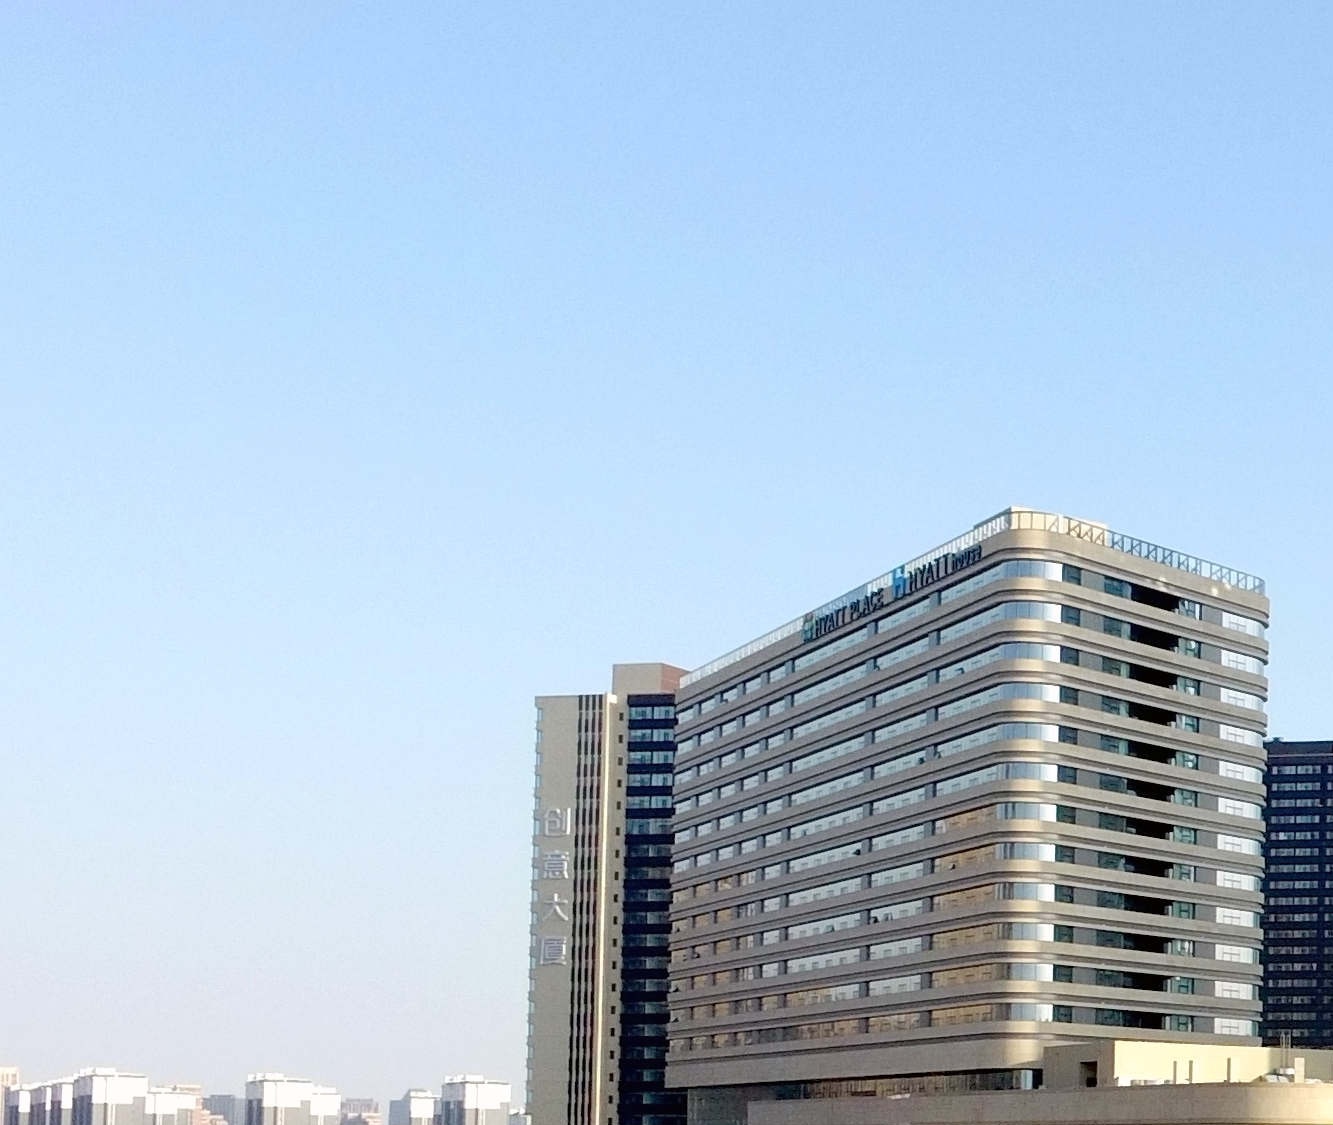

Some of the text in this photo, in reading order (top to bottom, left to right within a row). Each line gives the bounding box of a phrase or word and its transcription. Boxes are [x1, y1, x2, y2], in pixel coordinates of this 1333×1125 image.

[907, 552, 951, 592] HYATT
[815, 588, 884, 637] HYATT PLACE
[540, 807, 571, 966] 创意大厦
